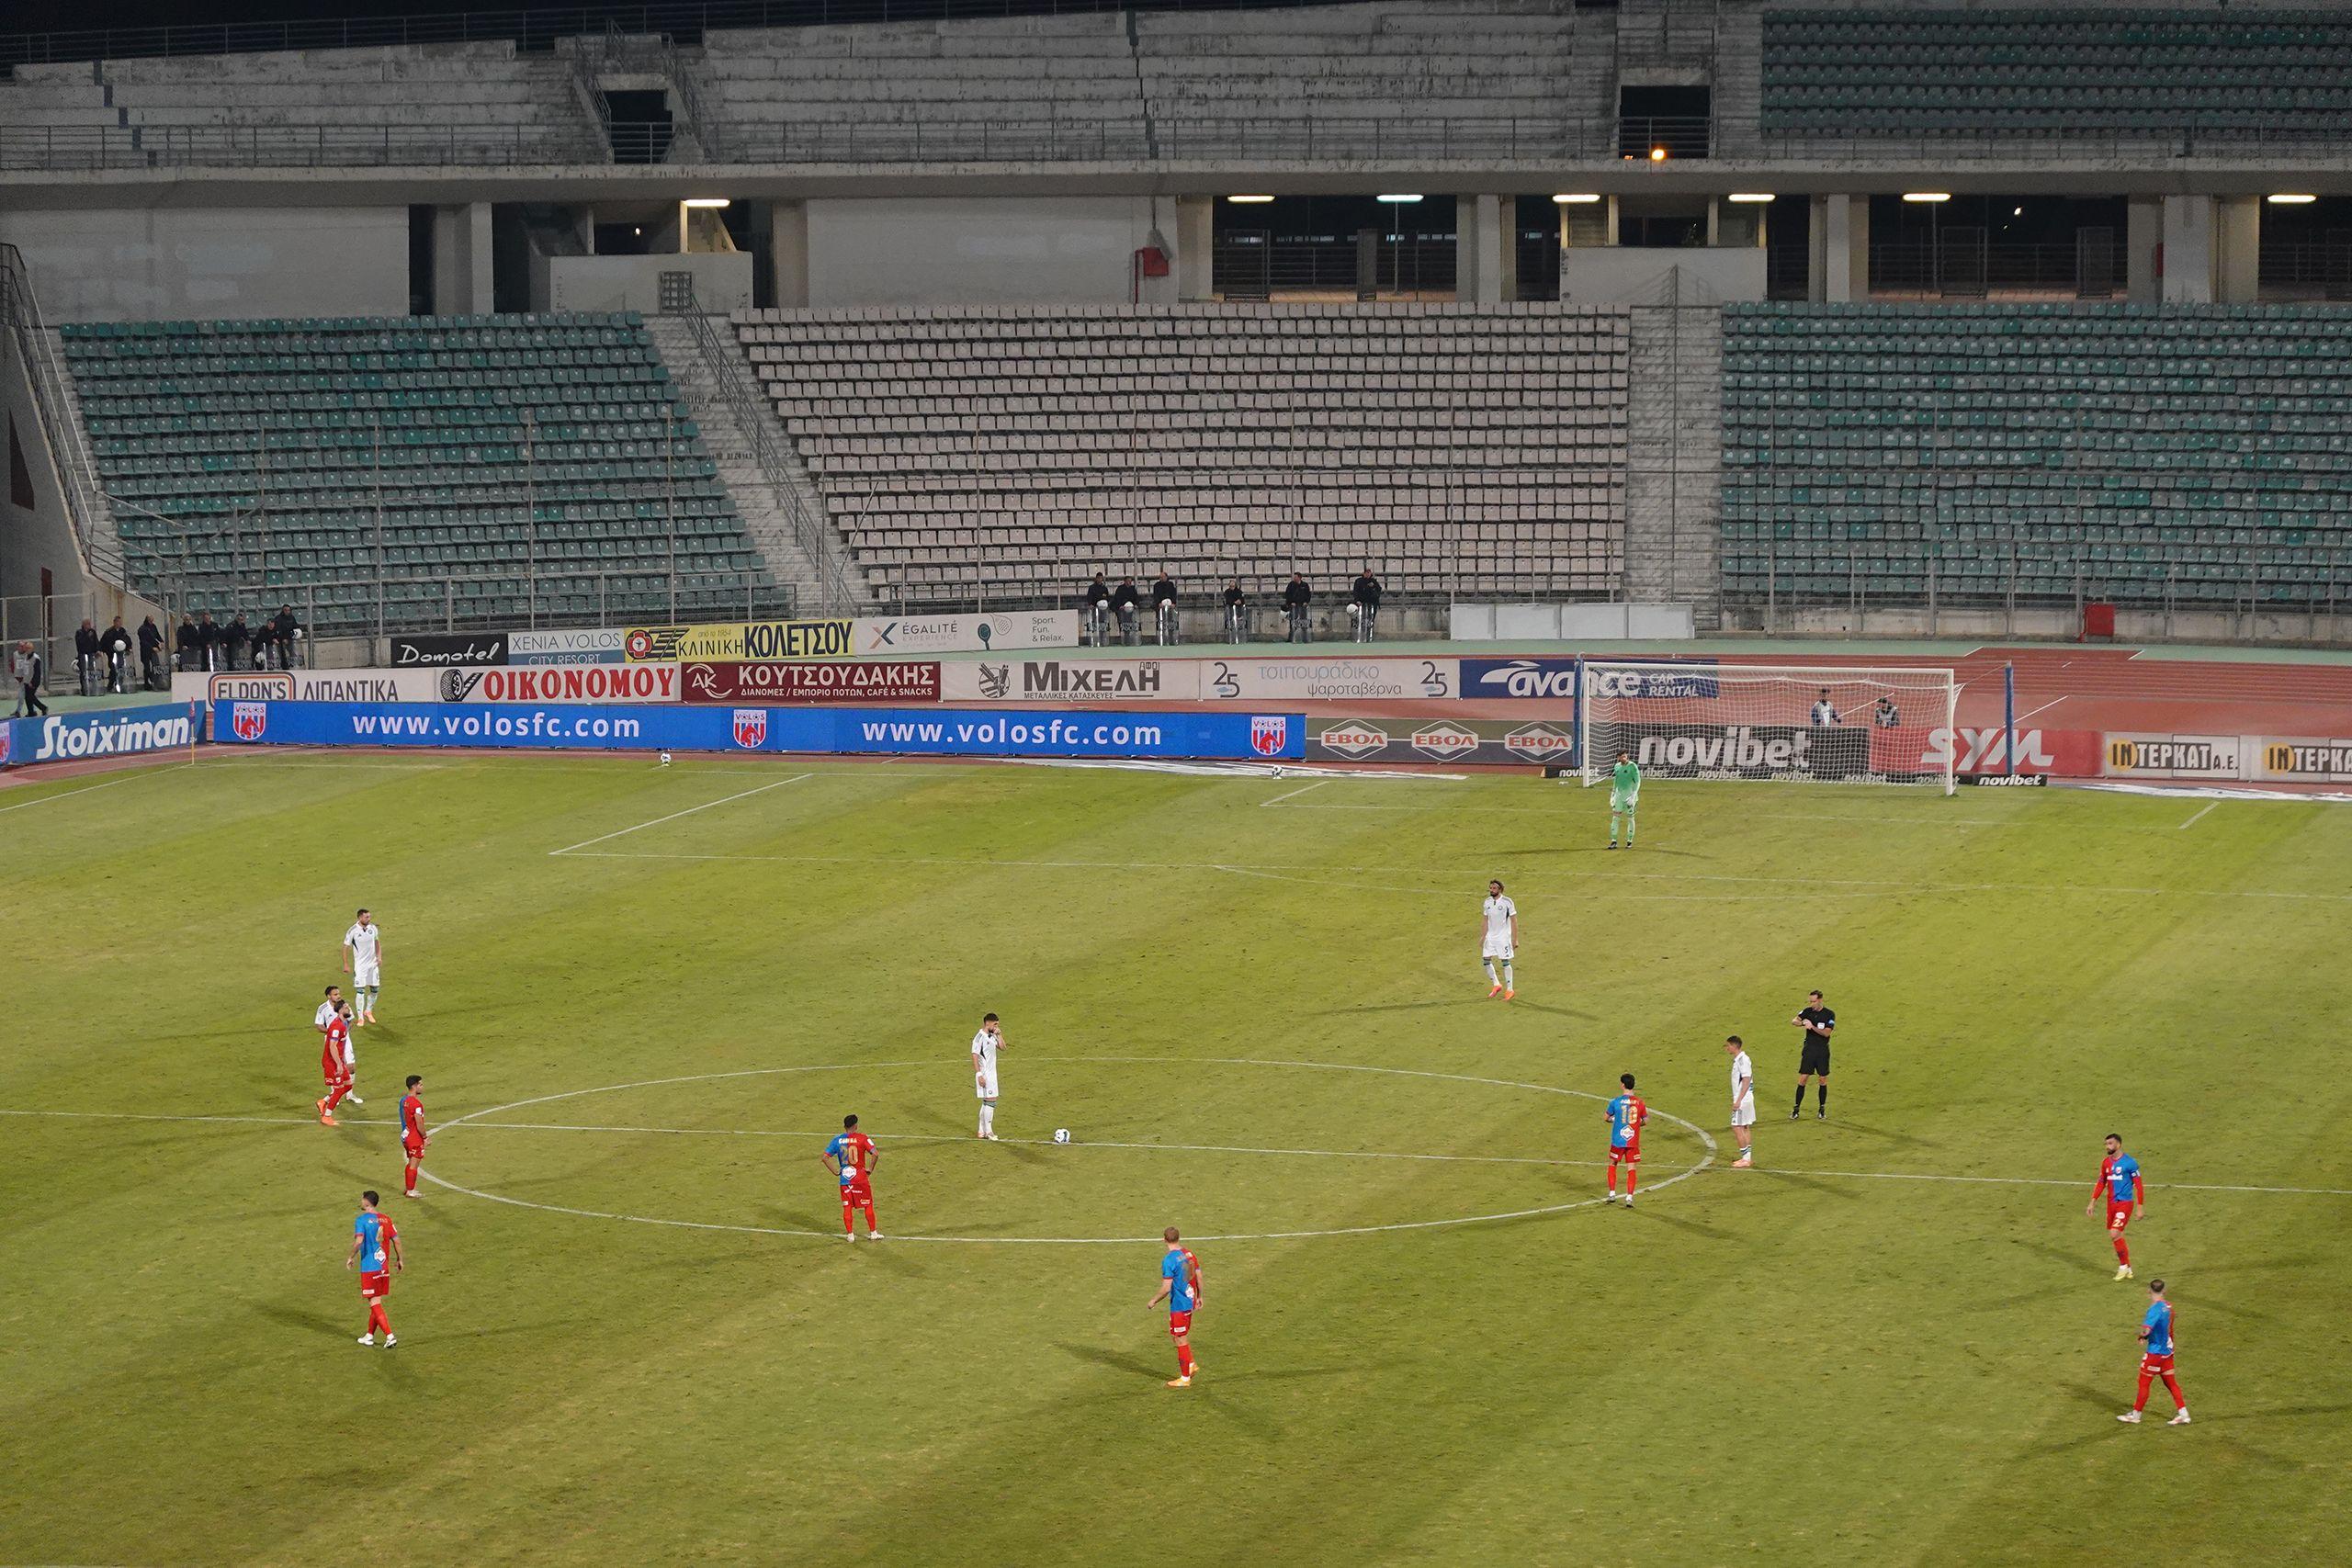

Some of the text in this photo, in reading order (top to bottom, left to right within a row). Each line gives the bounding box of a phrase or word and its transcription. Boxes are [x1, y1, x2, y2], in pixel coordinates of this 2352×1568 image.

[902, 620, 957, 635] ÉGALITÉ
[512, 632, 620, 650] XENIA VOLOS
[678, 638, 743, 656] ΚΛΙΝΙΚΗ
[744, 621, 853, 659] ΚΟΛΕΤΣΟΥ
[397, 642, 499, 665] Domotel
[528, 654, 600, 665] CITY RESORT
[738, 664, 934, 686] ΚΟΥΤΣΟΥΔΑΚΗΣ
[1213, 661, 1240, 698] 25
[1257, 661, 1380, 682] τσιπουράδικο
[1420, 660, 1448, 697] 25
[303, 680, 399, 701] ΛΙΠΑΝΤΙΚΑ
[483, 667, 674, 701] ΟΙΚΟΝΟΜΟΥ
[741, 688, 785, 696] ΔΙΑΝΟΜΕΣ
[793, 688, 831, 696] ΕΜΠΟΡΙΟ
[832, 688, 865, 697] ΠΟΤΩΝ,
[899, 688, 933, 696] SNACKS
[1307, 682, 1402, 696] ψαροταβέρνα
[1649, 685, 1699, 696] RENTAL
[353, 711, 640, 738] www.volosfc.com
[862, 718, 1161, 745] www.volosfc.com
[36, 716, 189, 760] Stoiximan
[1638, 726, 1812, 768] novibet
[1920, 728, 2055, 771] SYM
[1559, 765, 1600, 777] noviet
[1978, 773, 2042, 786] novibet
